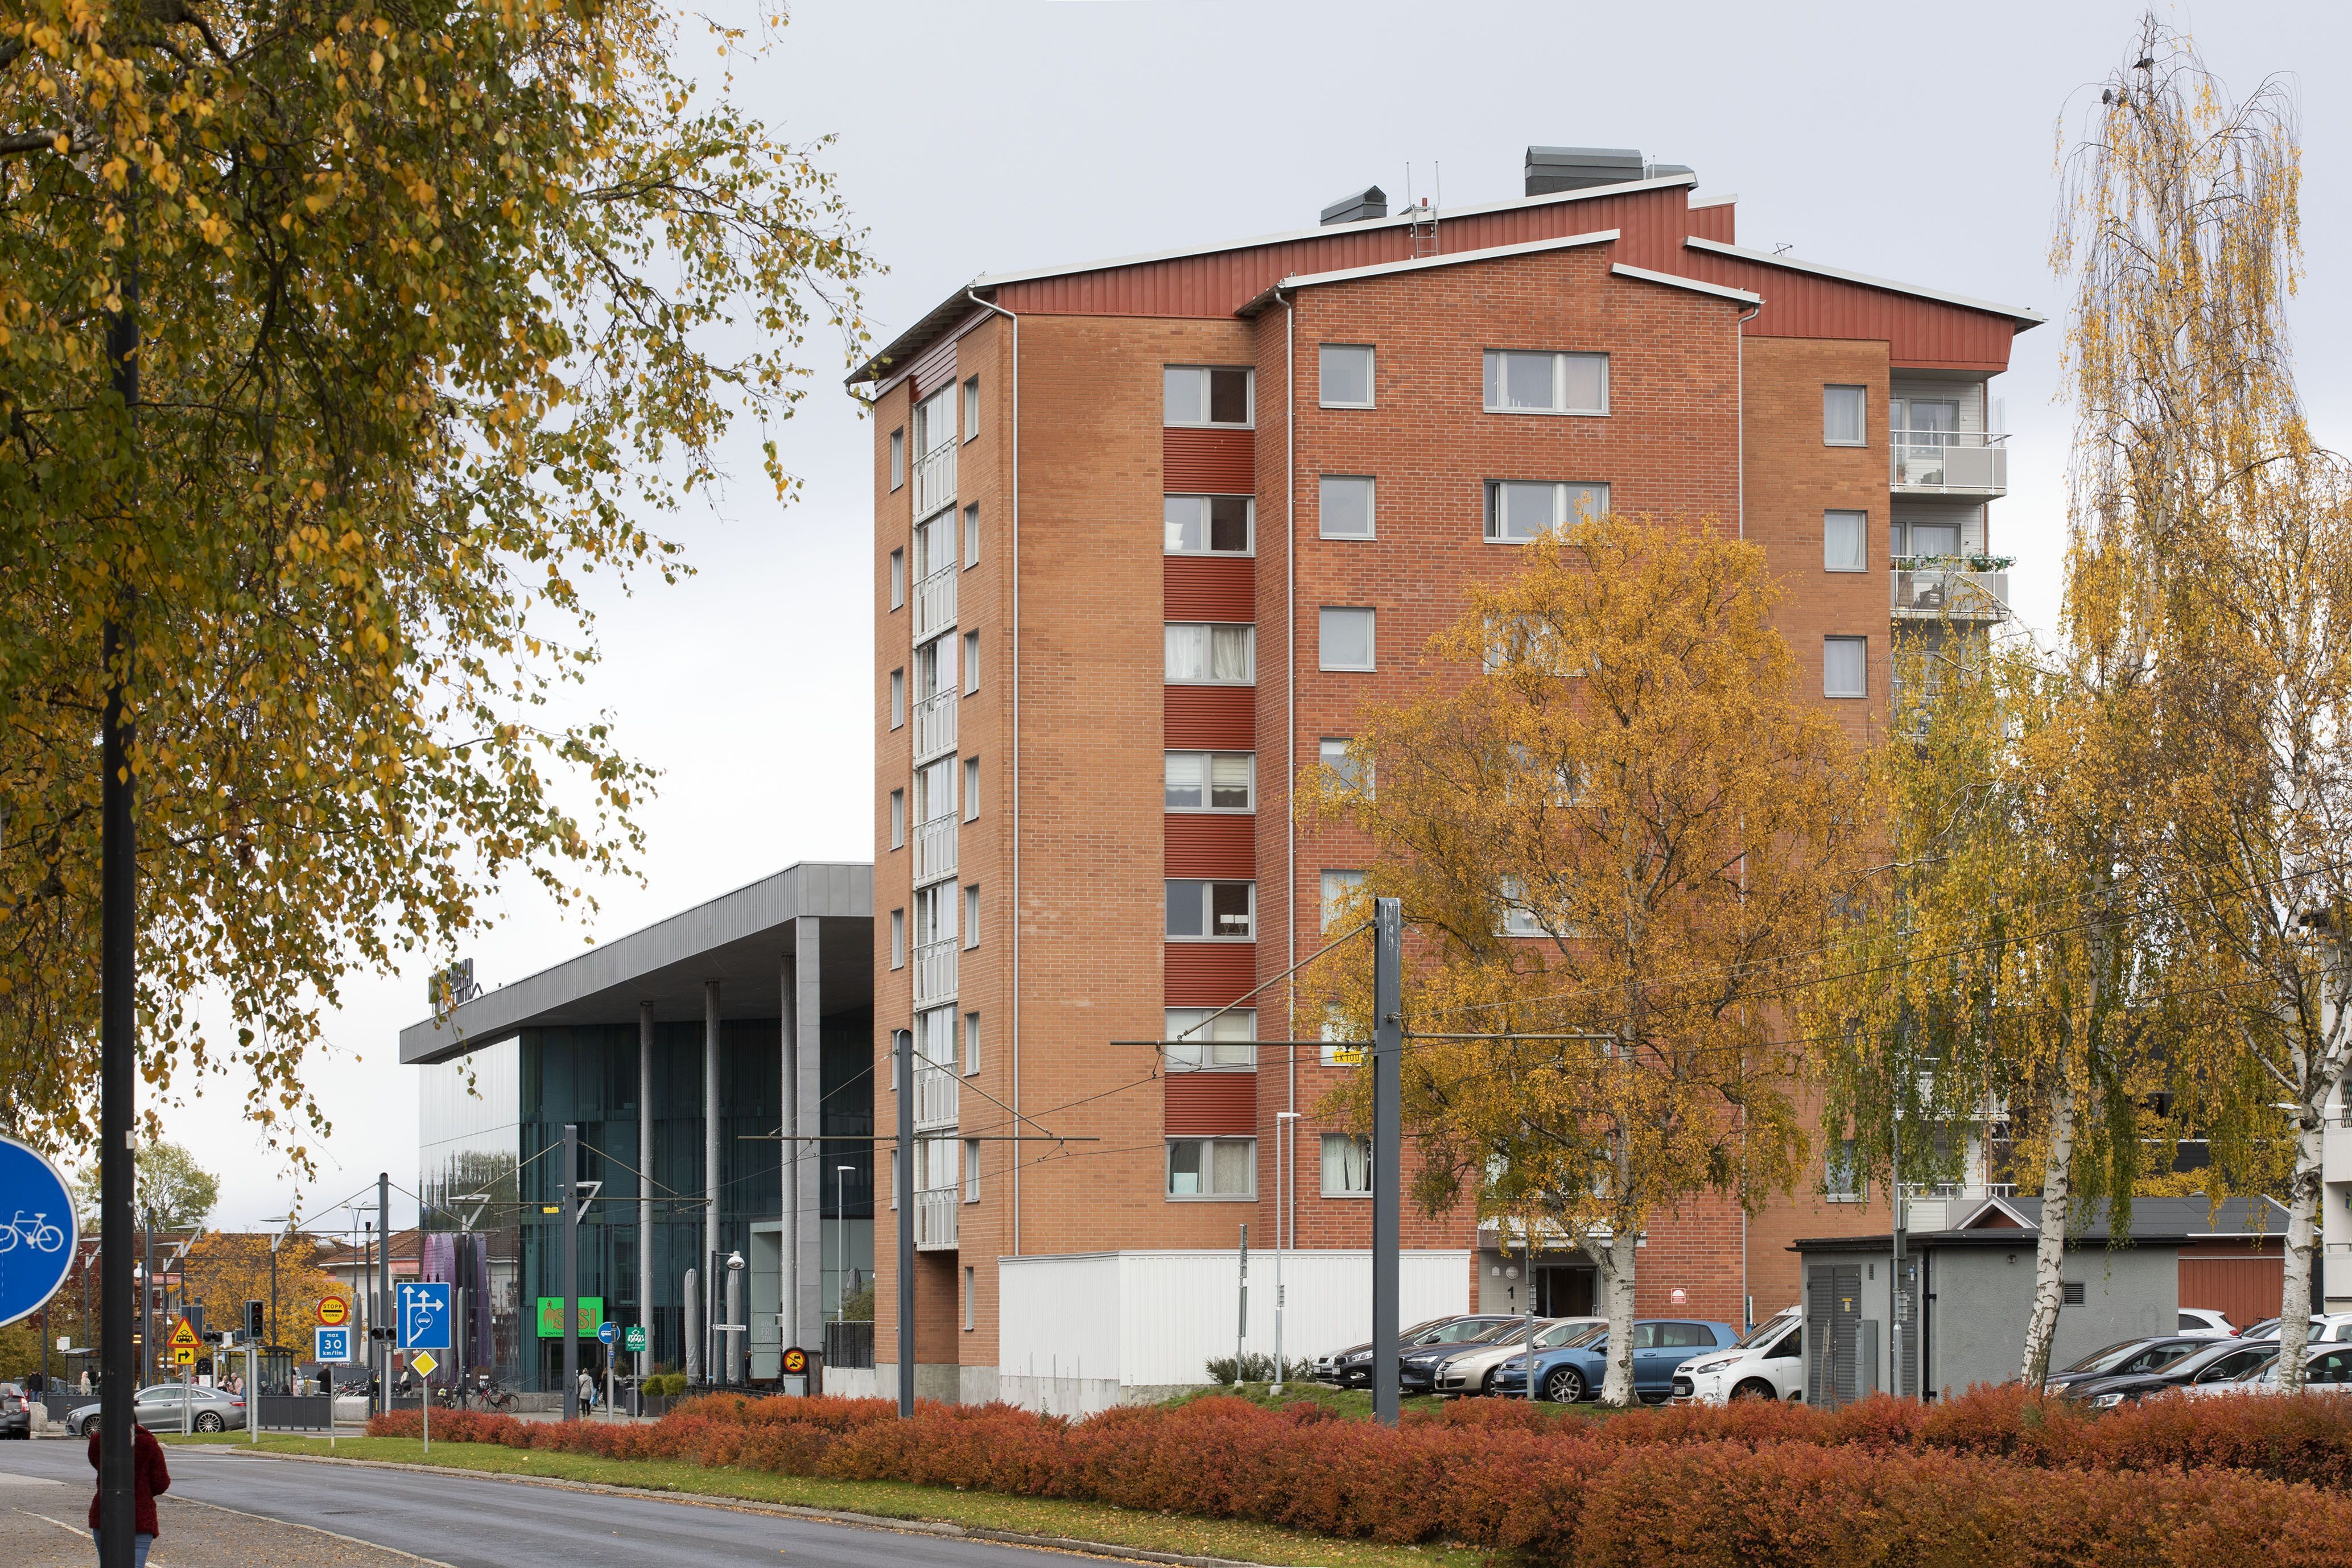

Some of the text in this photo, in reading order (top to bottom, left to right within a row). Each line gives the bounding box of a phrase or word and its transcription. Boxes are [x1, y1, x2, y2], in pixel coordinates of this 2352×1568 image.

[1508, 1286, 1513, 1299] 1
[554, 1308, 596, 1330] SSI
[324, 1339, 342, 1350] 30
